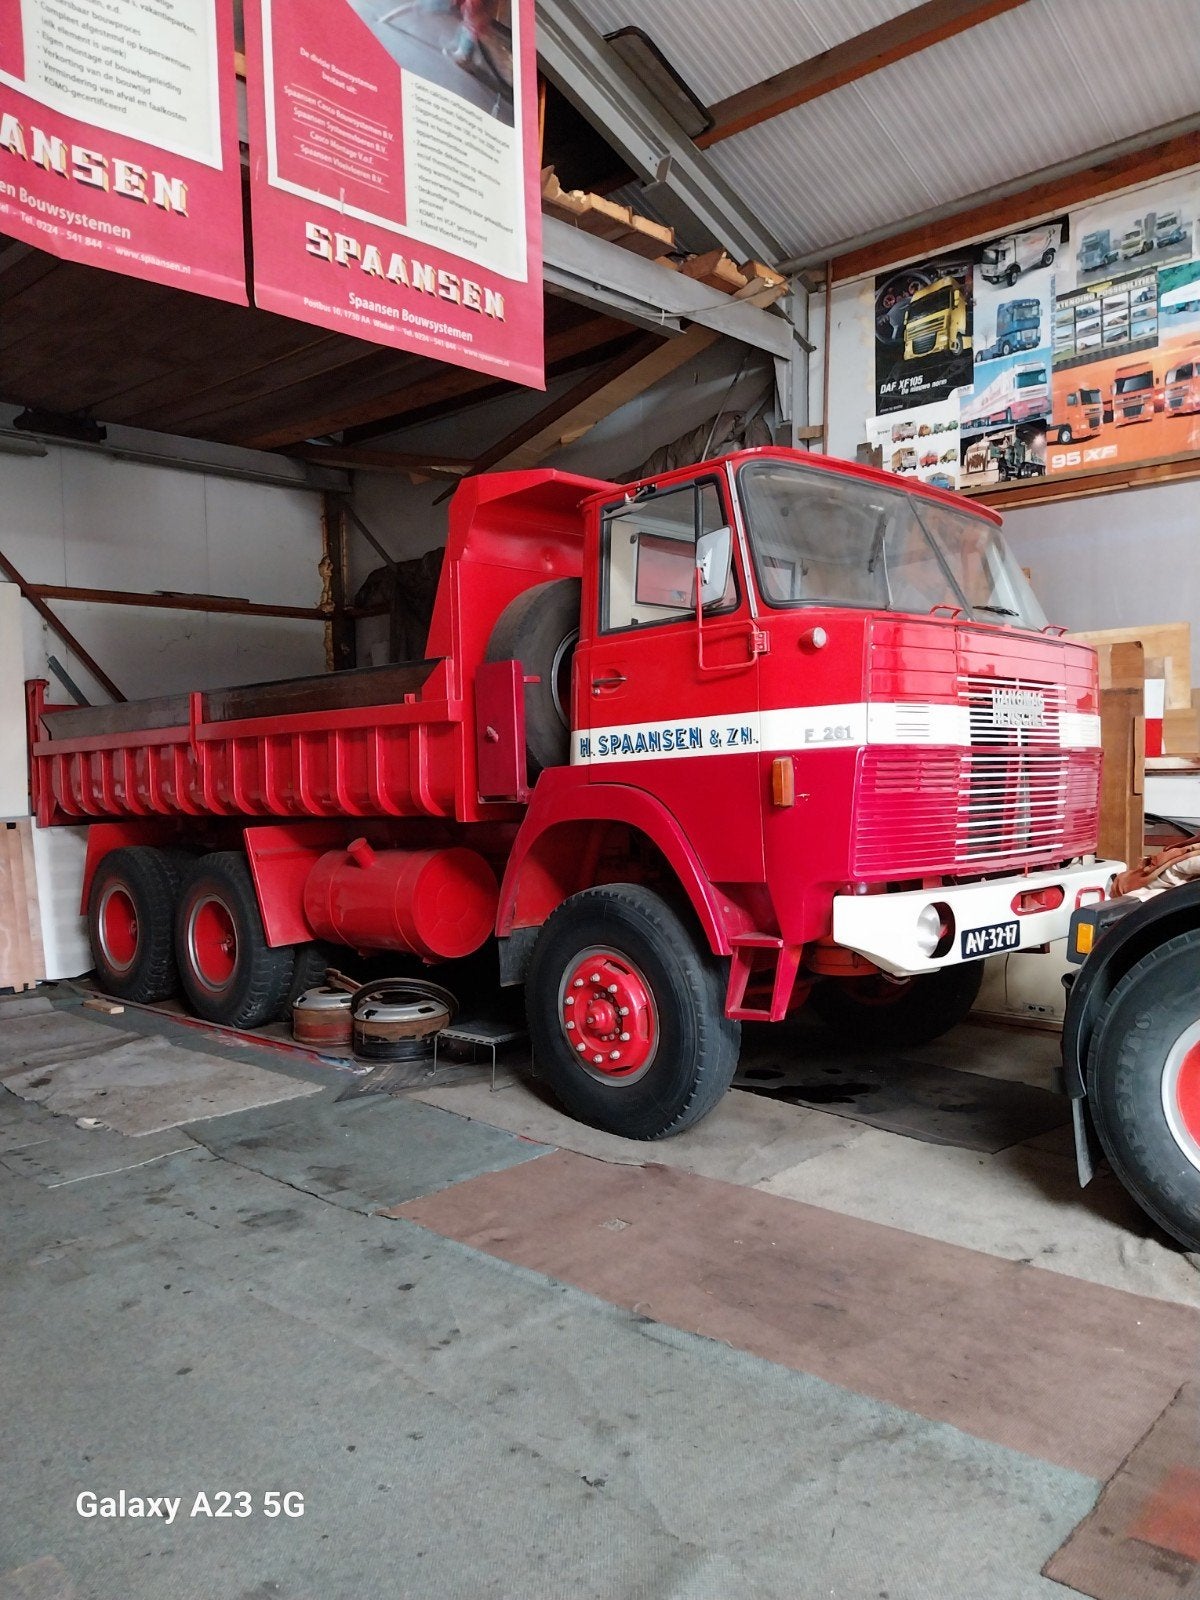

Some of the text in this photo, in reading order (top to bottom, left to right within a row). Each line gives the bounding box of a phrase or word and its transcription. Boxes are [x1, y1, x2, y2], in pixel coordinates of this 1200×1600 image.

[40, 2, 191, 71] Compleet afgestemd op koperswensen
[58, 26, 90, 46] element
[93, 39, 99, 48] is
[92, 11, 141, 36] bouwproces
[42, 31, 182, 95] Eigen montage of bouwbegeleiding
[300, 46, 309, 58] De
[43, 46, 151, 95] Verkorting van de bouwtijd
[44, 60, 187, 122] Vermindering van afval en faalkosten
[44, 75, 127, 114] KOMO-gecertificeerd
[284, 86, 316, 105] Spaansen
[317, 100, 336, 115] Casco
[336, 110, 382, 136] Bouwsystemen
[294, 106, 325, 126] Spaansen
[310, 130, 330, 145] Casco
[300, 144, 332, 163] Spaansen
[20, 187, 130, 239] Bouwsystemen
[36, 220, 58, 236] 0224
[67, 232, 82, 242] 541
[115, 245, 191, 274] www.spaansen.nl
[305, 222, 505, 322] SPAANSEN
[304, 297, 332, 313] Postbus
[349, 292, 472, 342] Spaansen Bouwsystemen
[880, 375, 924, 394] DAF XF105
[910, 382, 930, 393] nieuwe
[1052, 444, 1118, 468] 95 XF
[579, 726, 759, 758] H. SPAANSEN & ZN.
[804, 726, 851, 743] F 261
[966, 924, 1018, 954] AV-32-17
